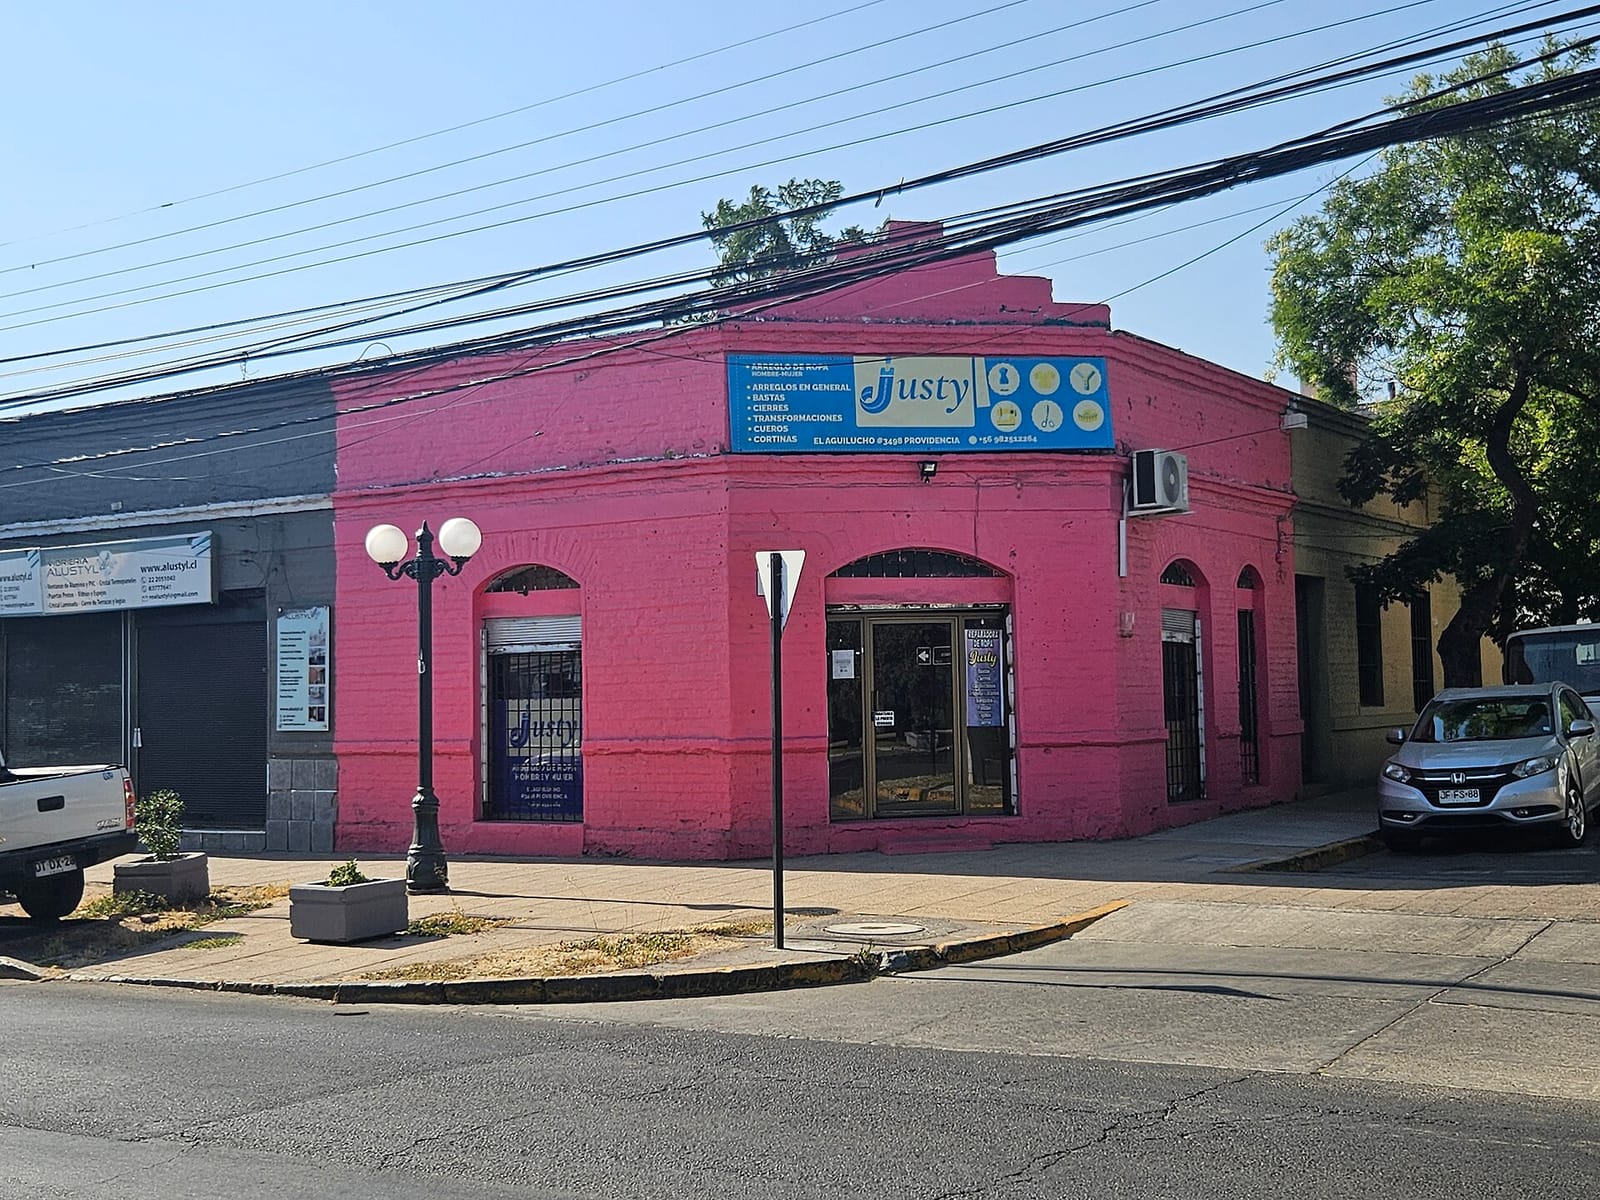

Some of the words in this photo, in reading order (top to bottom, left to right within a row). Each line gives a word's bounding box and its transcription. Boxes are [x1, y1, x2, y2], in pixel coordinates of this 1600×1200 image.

[753, 404, 789, 412] CIERRES
[753, 414, 843, 422] TRANSFORMACIONES
[47, 565, 99, 576] ALUSTYL
[140, 560, 197, 573] www.alustyl.cl
